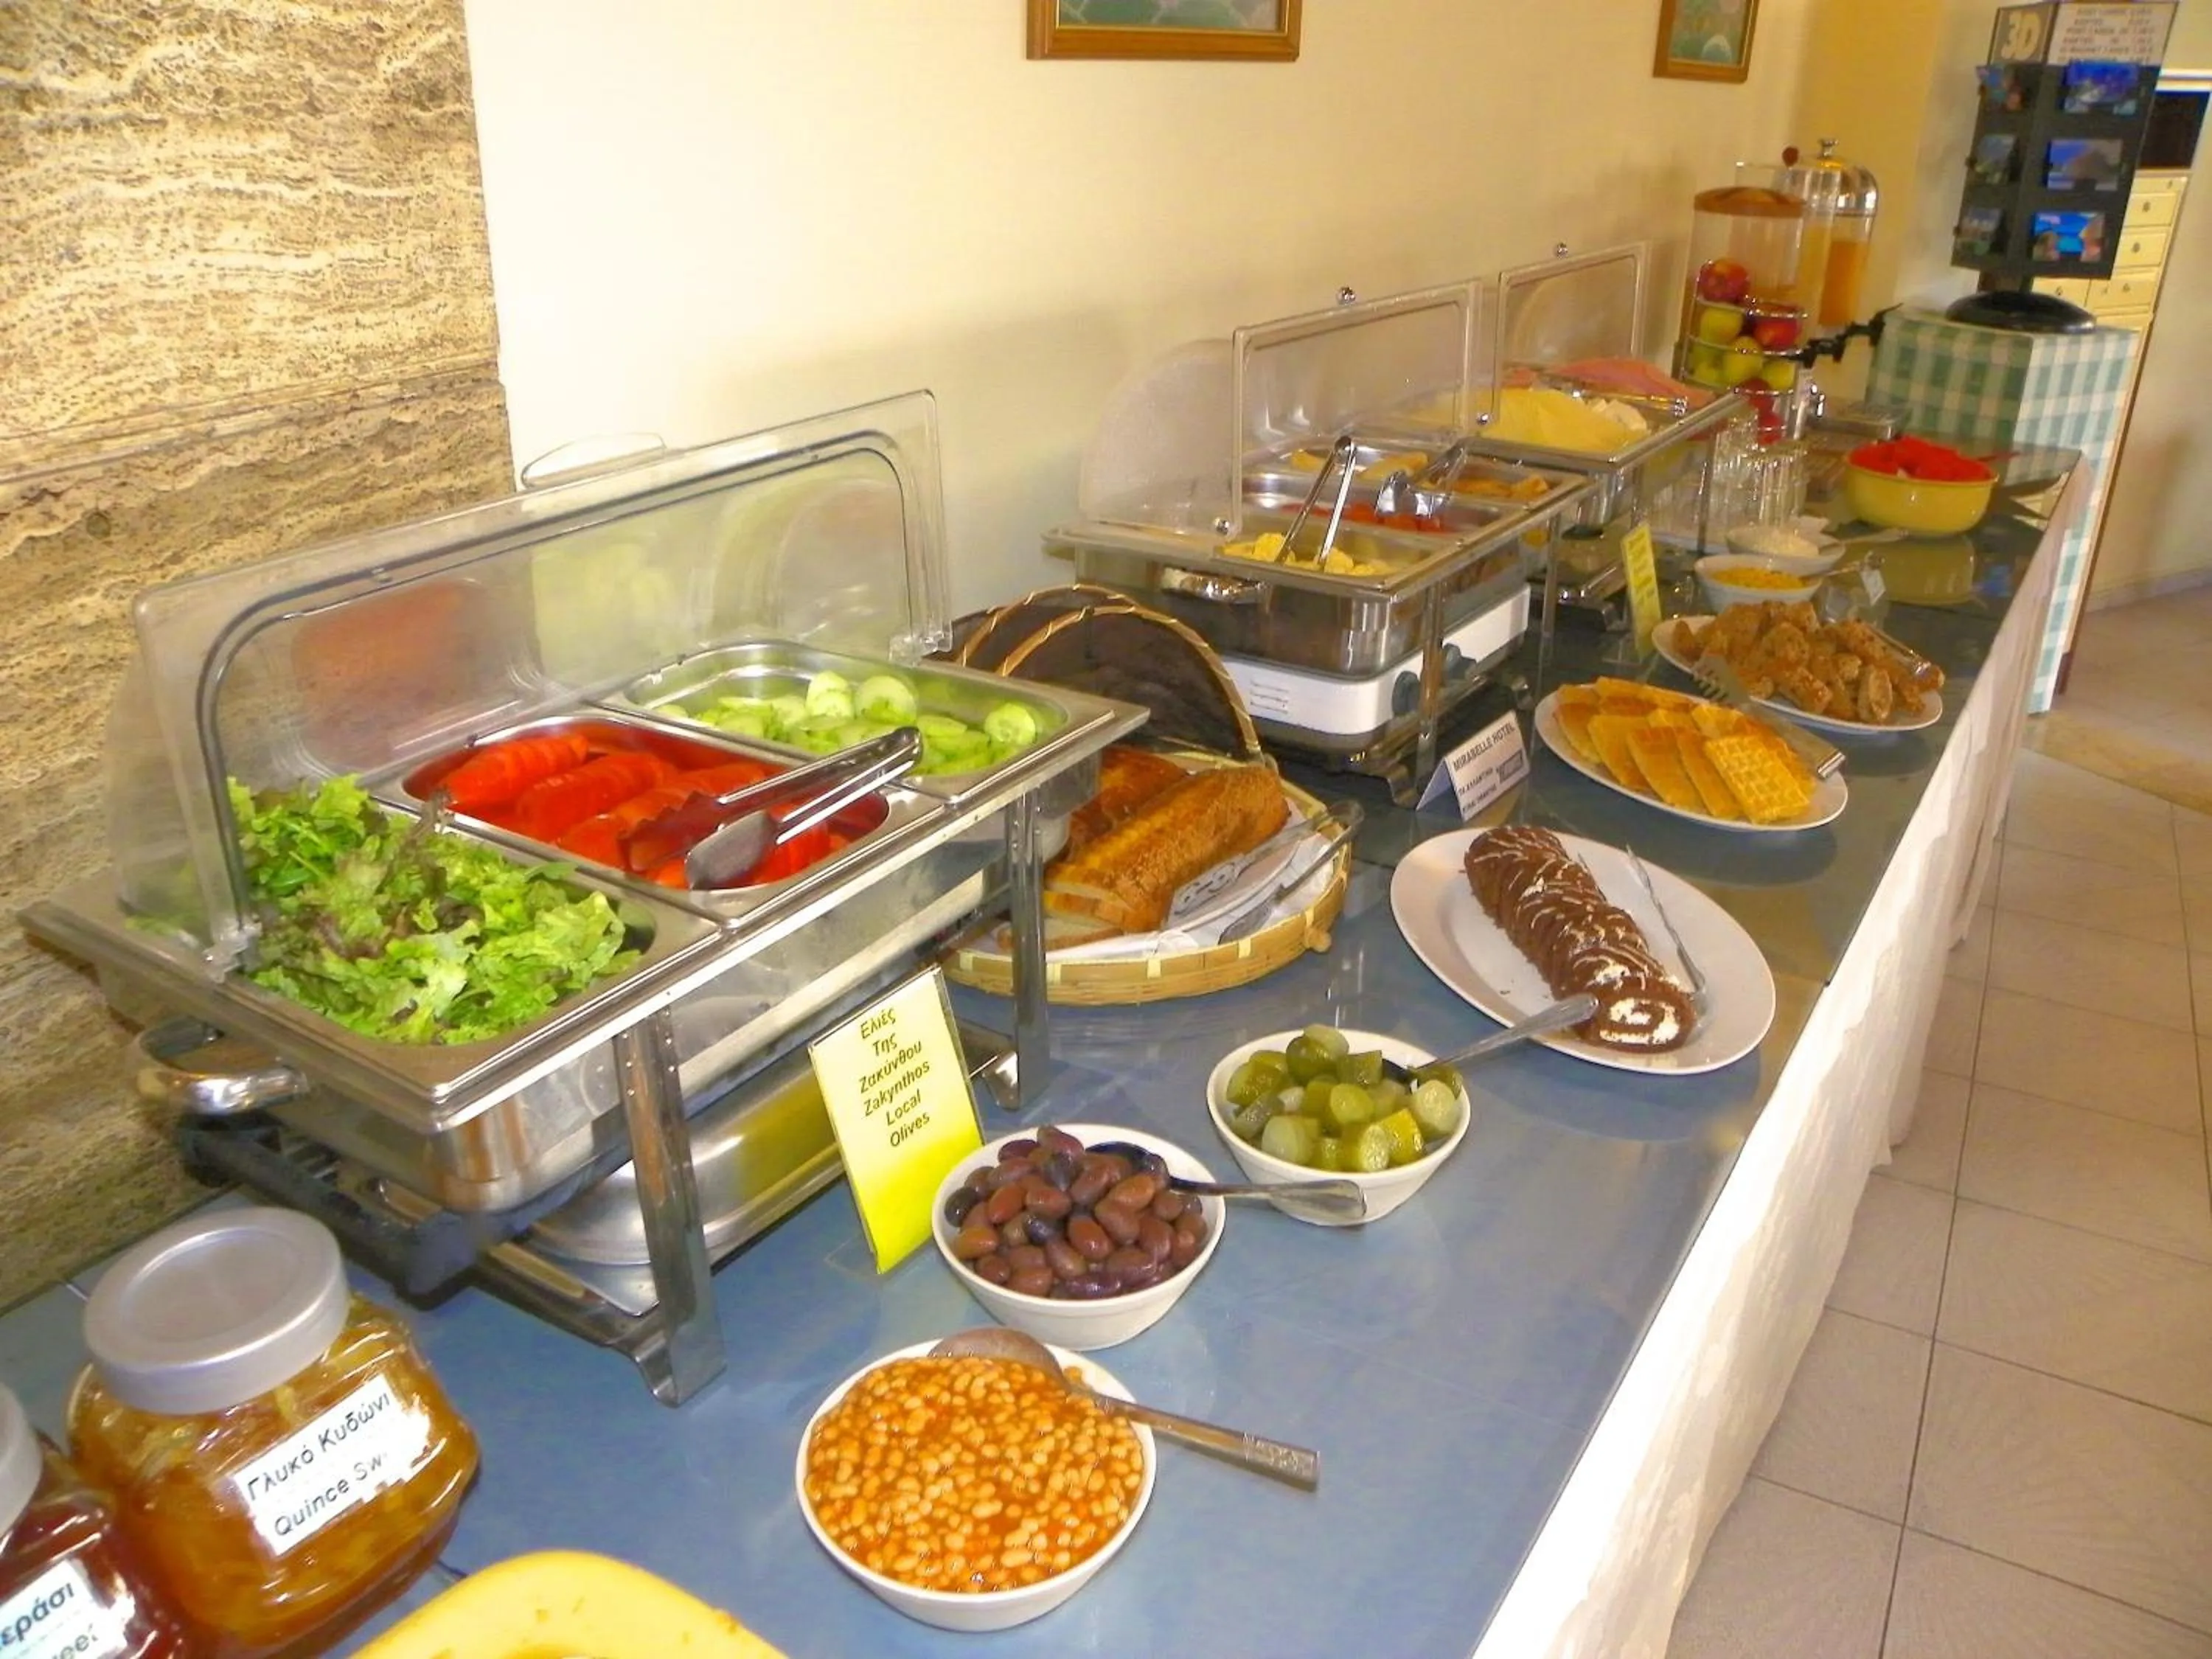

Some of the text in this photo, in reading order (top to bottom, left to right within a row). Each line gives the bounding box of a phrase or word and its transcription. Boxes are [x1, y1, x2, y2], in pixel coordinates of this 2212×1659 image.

[1453, 722, 1514, 772] MIRABELLE HOTEL
[860, 1007, 897, 1040] Ελιές
[859, 1040, 922, 1093] Ζακύνθου
[863, 1061, 931, 1118] Zakynthos
[886, 1089, 922, 1127] Local
[890, 1112, 931, 1148] Olives
[246, 1392, 391, 1501] Γλυκό Κυδώνι
[274, 1478, 349, 1537] Quince
[0, 1583, 74, 1646] εράσι
